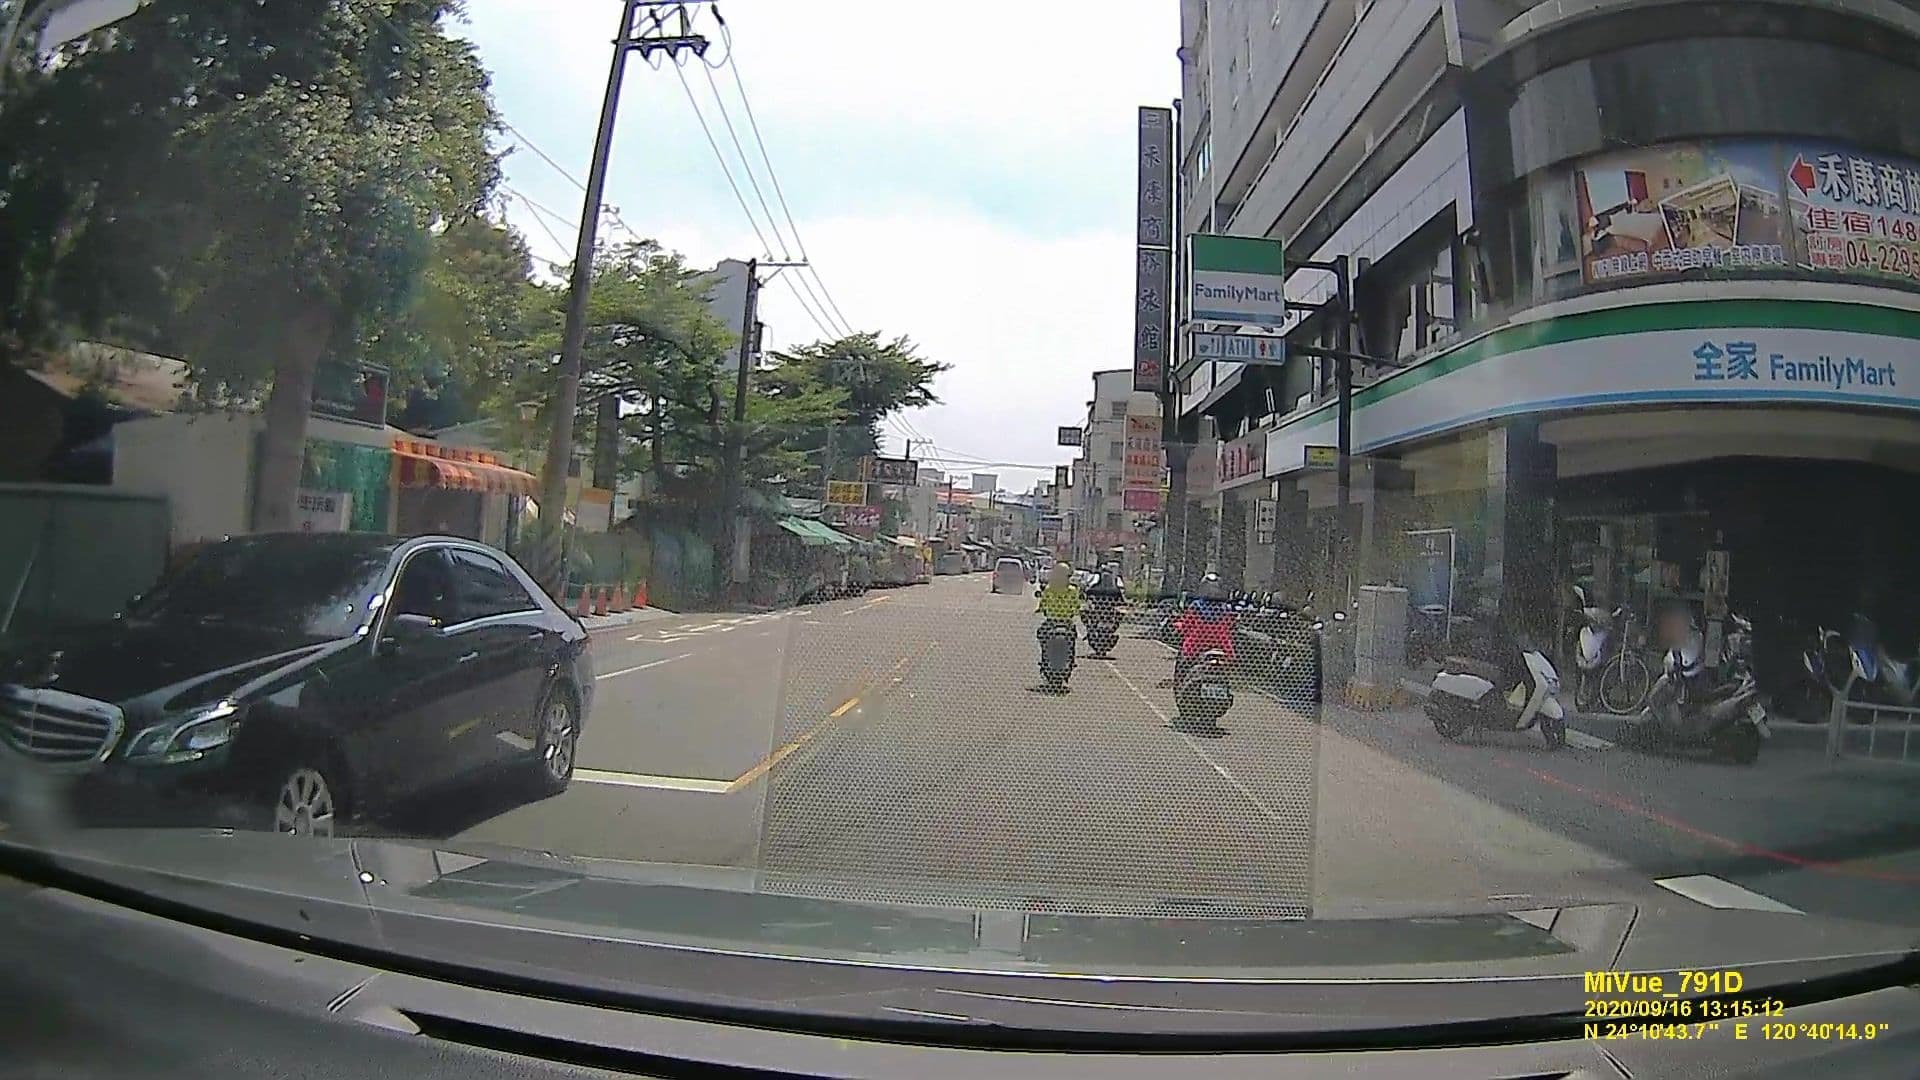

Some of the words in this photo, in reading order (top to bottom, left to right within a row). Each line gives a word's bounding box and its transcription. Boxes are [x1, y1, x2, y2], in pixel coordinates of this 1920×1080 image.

[1195, 283, 1280, 304] FamilyMart
[1227, 340, 1250, 357] ATM
[1693, 341, 1759, 381] 全家
[1770, 353, 1896, 389] FamilyMart
